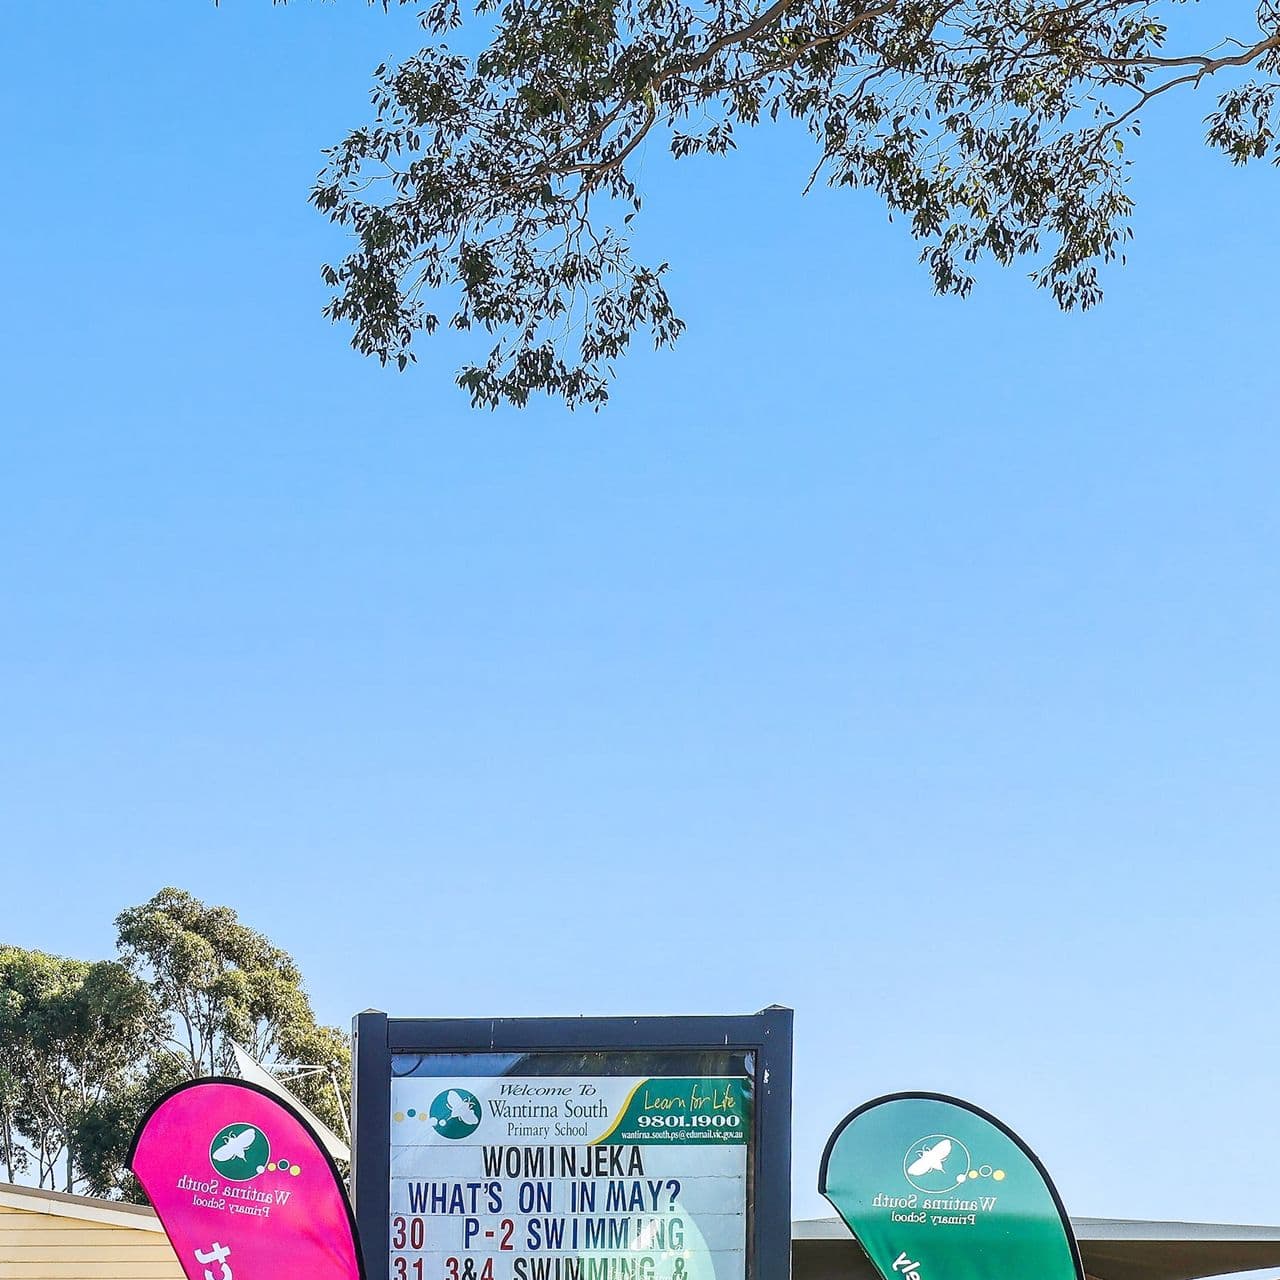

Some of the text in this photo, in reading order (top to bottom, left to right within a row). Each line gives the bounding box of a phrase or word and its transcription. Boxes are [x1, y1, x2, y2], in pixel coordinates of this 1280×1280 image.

[500, 1084, 597, 1096] Welcome To
[644, 1083, 736, 1112] Learn for Life
[488, 1098, 608, 1118] Wantirna South
[507, 1122, 588, 1139] Primary School
[637, 1114, 740, 1128] 9801.1900
[482, 1145, 645, 1178] WOMINJEKA
[518, 1181, 553, 1213] ON
[571, 1181, 596, 1213] IN
[605, 1179, 681, 1212] MAY?
[392, 1216, 424, 1250] 30
[526, 1217, 684, 1250] SWIMMING
